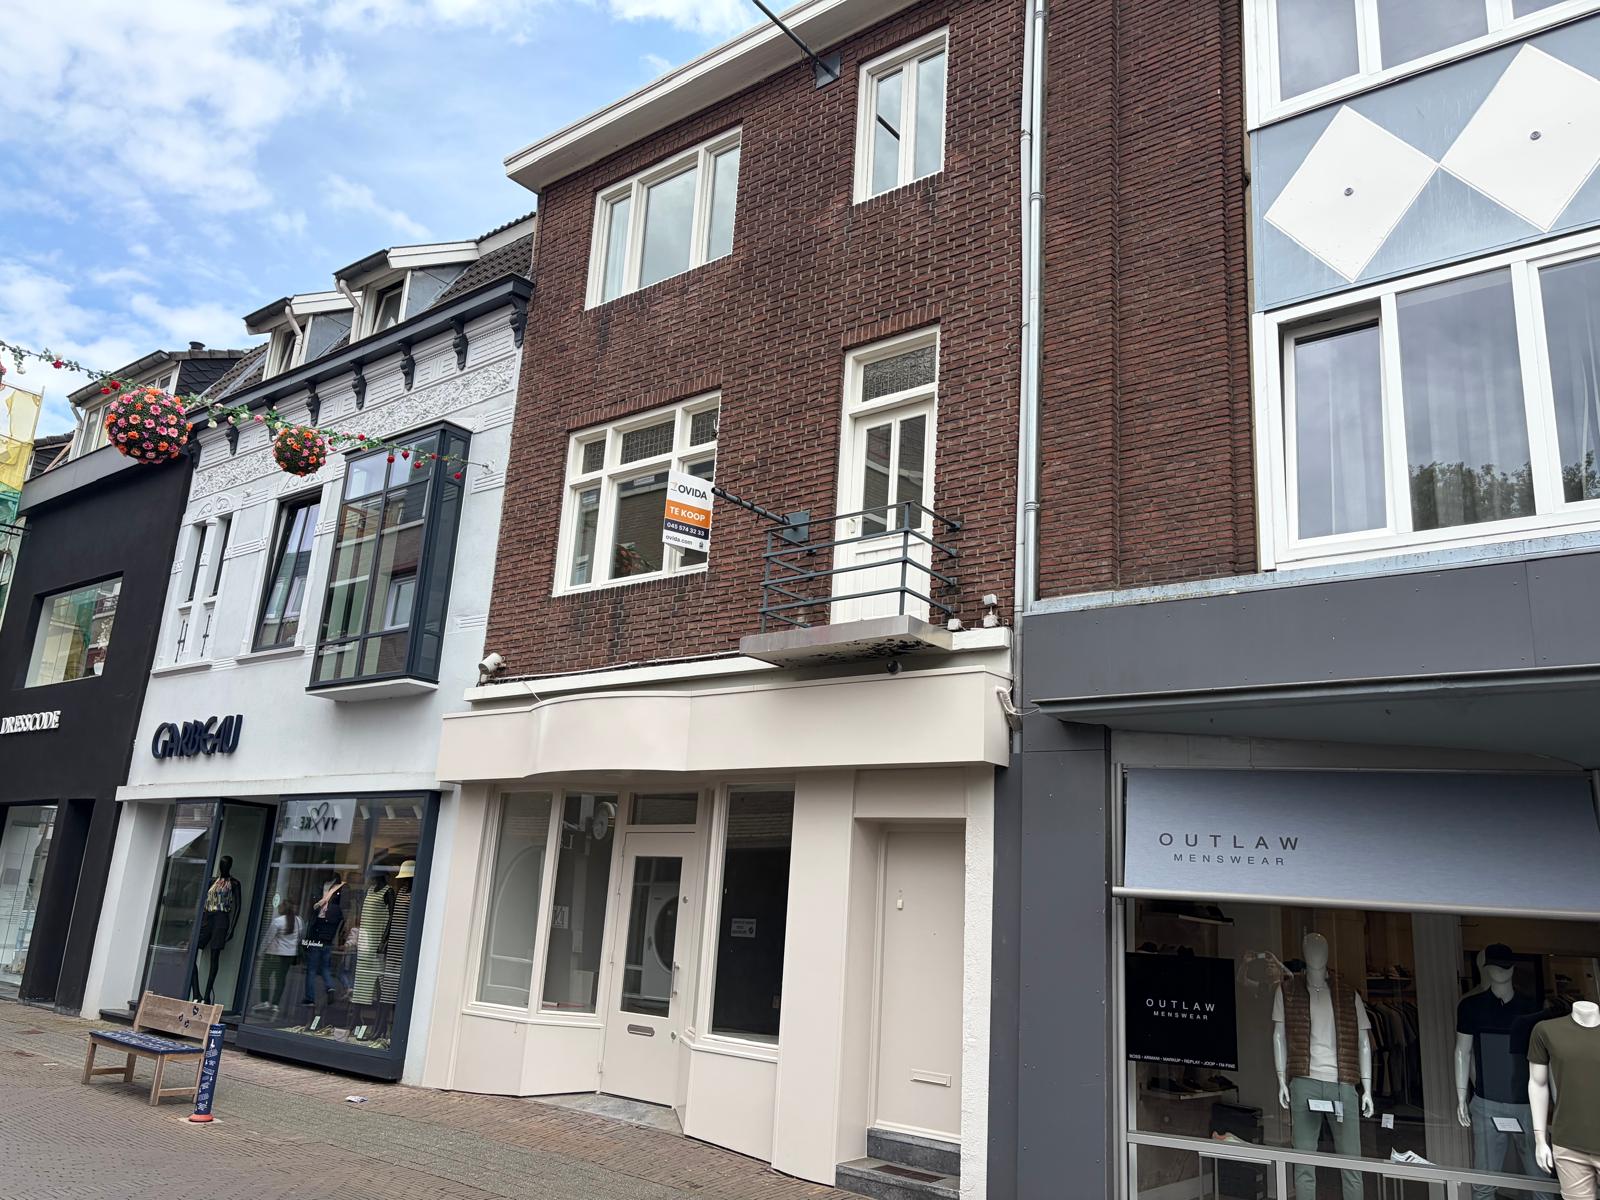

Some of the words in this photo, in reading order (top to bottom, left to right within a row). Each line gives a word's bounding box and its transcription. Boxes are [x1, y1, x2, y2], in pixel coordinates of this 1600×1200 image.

[670, 506, 680, 515] TE
[681, 509, 706, 522] KOOP
[666, 522, 678, 530] 045
[679, 525, 689, 533] 574
[689, 527, 697, 535] 32
[0, 710, 61, 735] DRESSCODE
[151, 714, 244, 760] GARBEAU
[1158, 832, 1299, 851] OUTLAW
[1173, 853, 1285, 866] MENSWEAR
[1146, 998, 1215, 1012] OUTLAW
[1153, 1010, 1208, 1021] MENSWEAR
